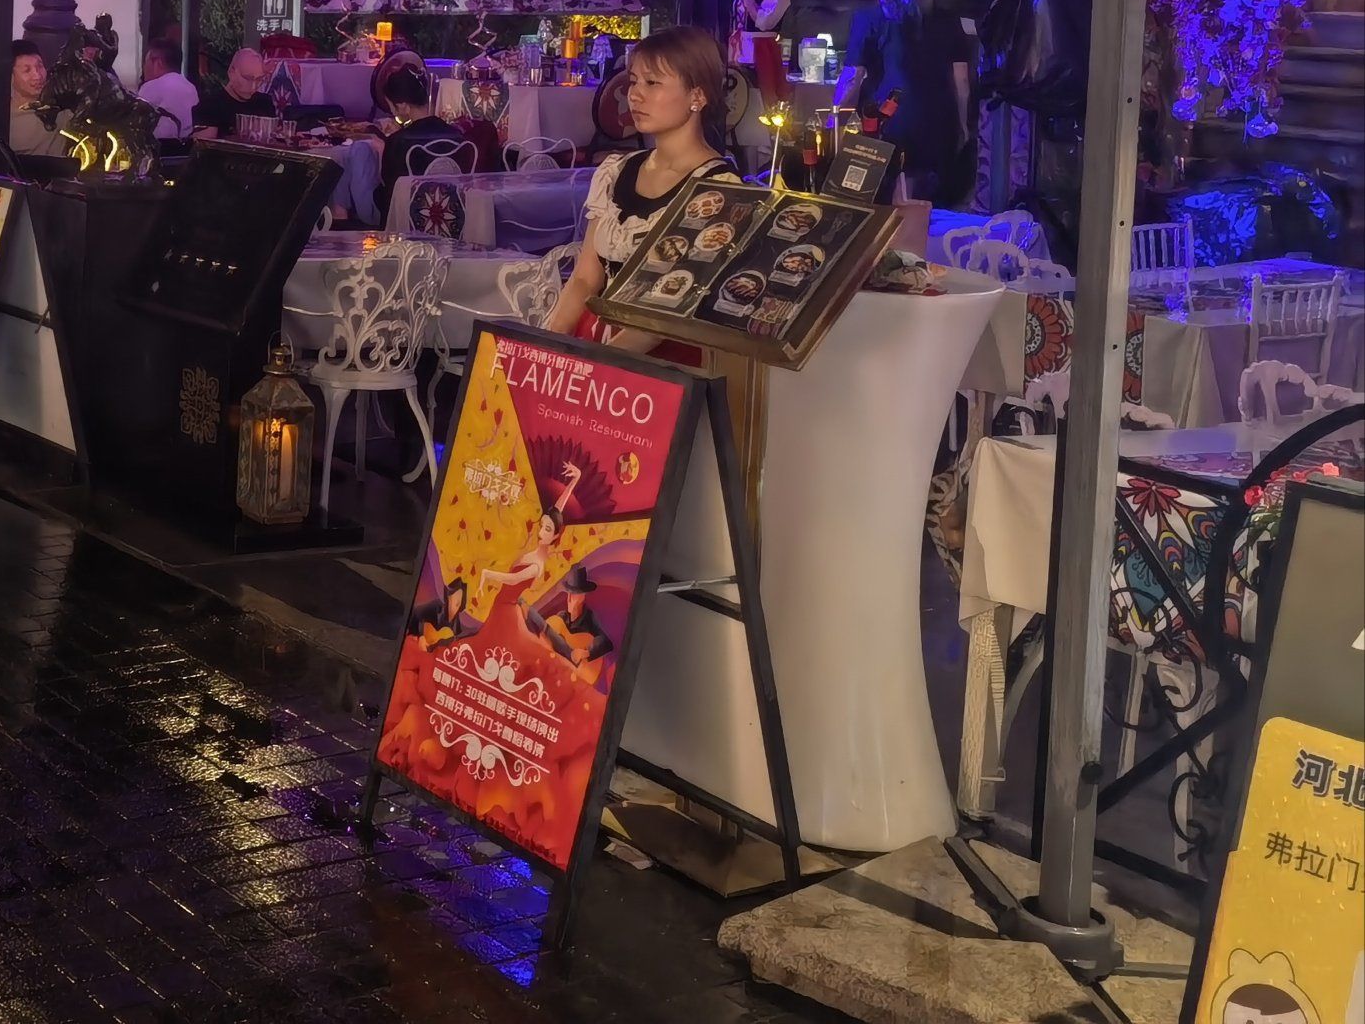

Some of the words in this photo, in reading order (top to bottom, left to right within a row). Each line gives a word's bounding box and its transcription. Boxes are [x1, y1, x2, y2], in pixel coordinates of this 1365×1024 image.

[256, 19, 293, 31] 洗手间
[490, 352, 654, 425] FLAMENCO
[537, 403, 584, 427] Spanish
[589, 419, 653, 449] Restaurant
[1264, 830, 1365, 894] 弗拉门
